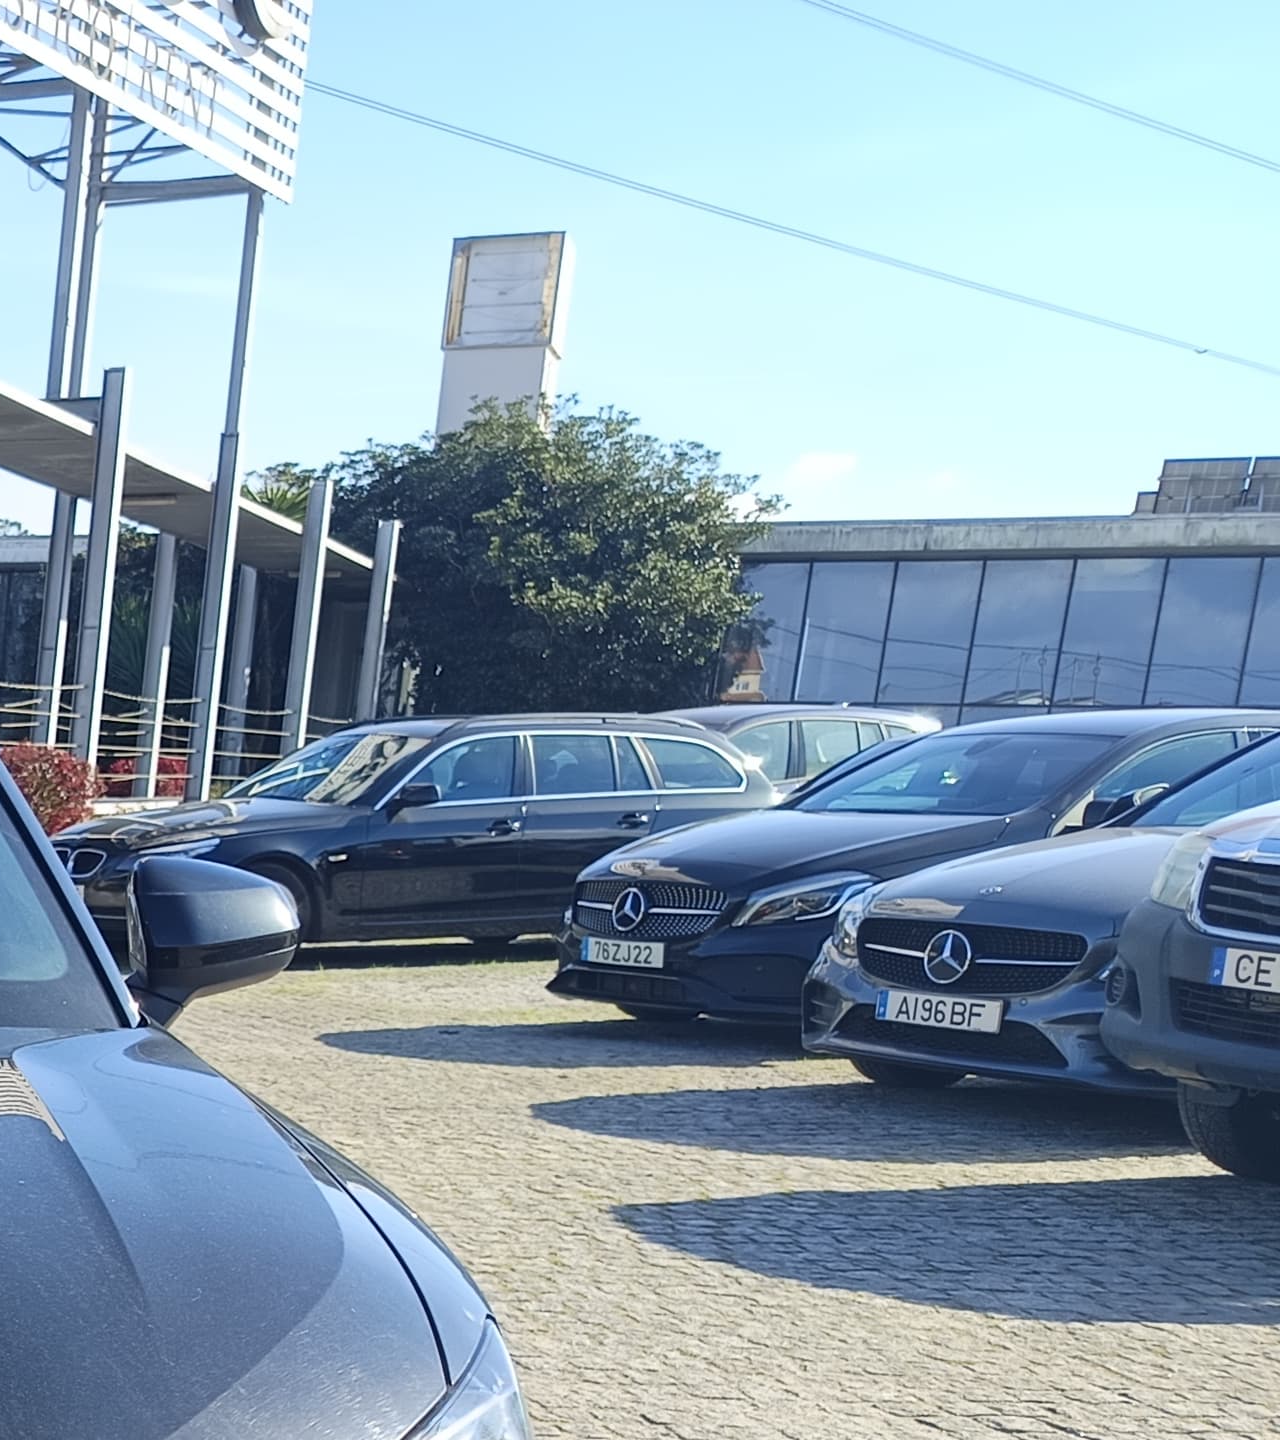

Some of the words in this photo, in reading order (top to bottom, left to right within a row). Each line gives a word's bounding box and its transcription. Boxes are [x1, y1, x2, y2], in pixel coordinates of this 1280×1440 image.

[139, 34, 224, 139] RENT
[594, 940, 653, 965] 76ZJ22
[894, 995, 987, 1028] AI96BF
